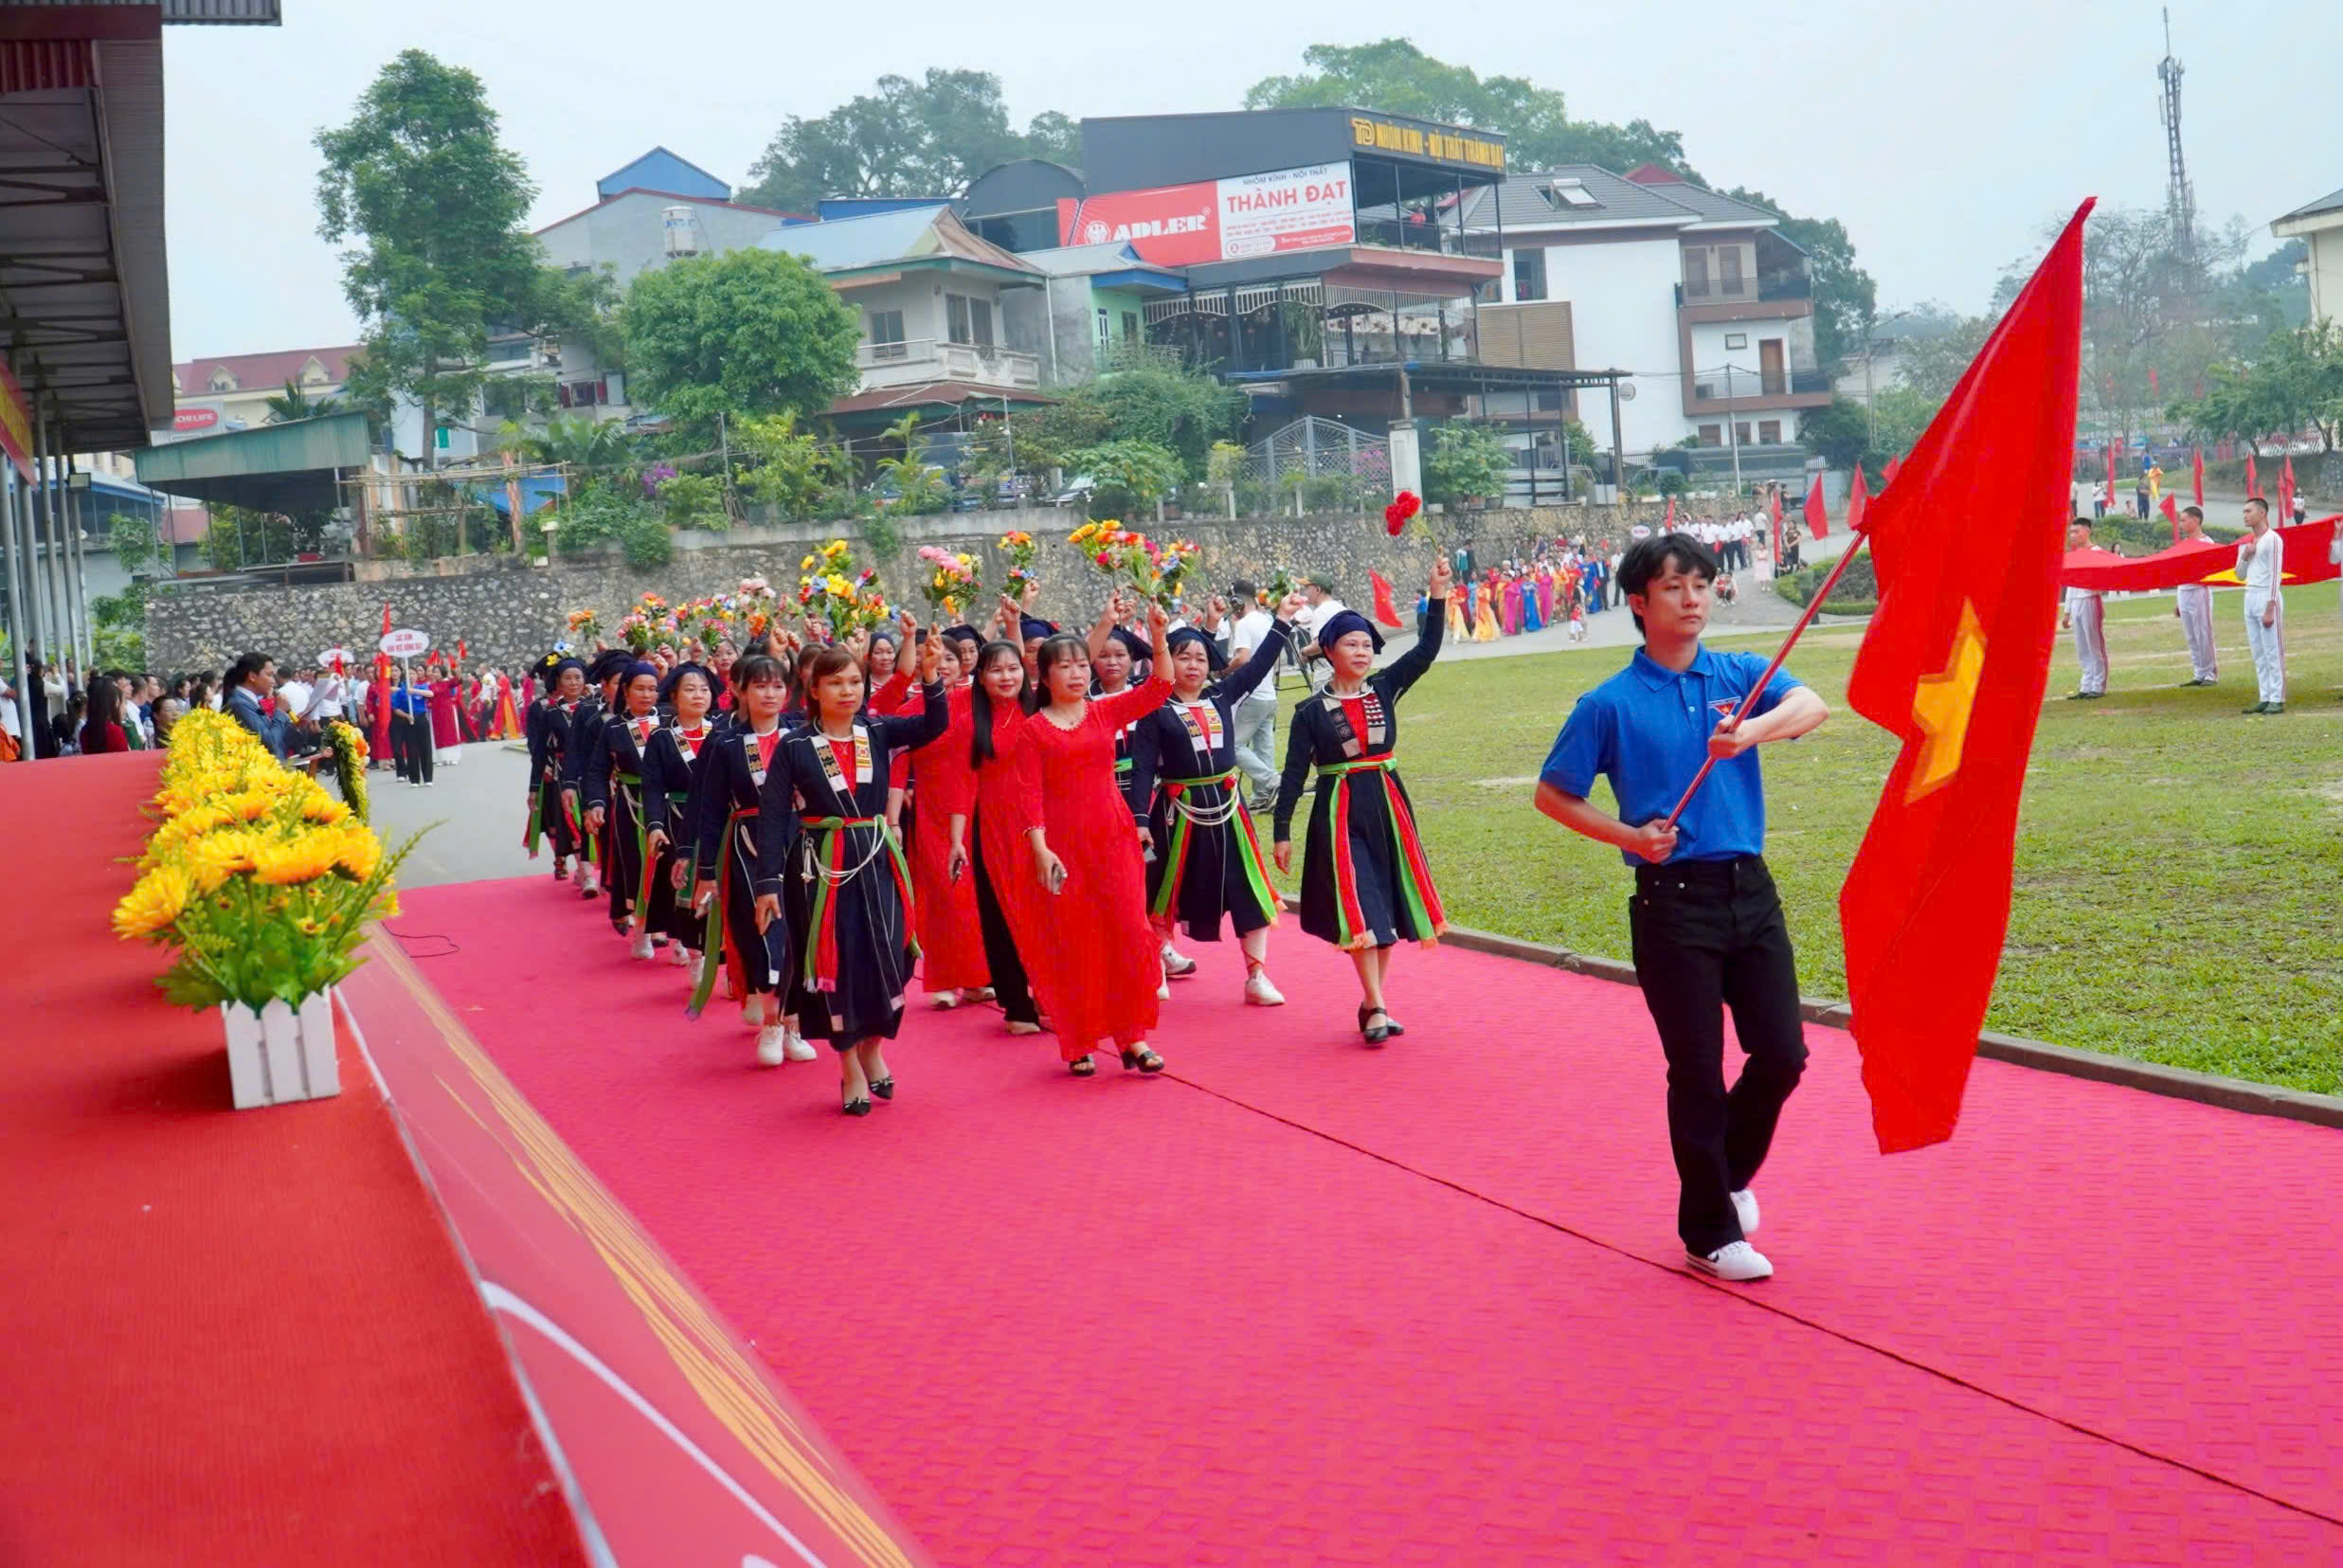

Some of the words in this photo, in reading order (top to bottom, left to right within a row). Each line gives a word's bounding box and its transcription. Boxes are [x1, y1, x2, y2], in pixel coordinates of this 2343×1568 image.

[1243, 175, 1267, 186] NHÔM
[1269, 171, 1287, 182] KÍNH
[1293, 169, 1307, 180] NỘI
[1309, 165, 1327, 176] THẤT
[1227, 188, 1298, 212] THÀNH
[1306, 181, 1346, 205] ĐẠT
